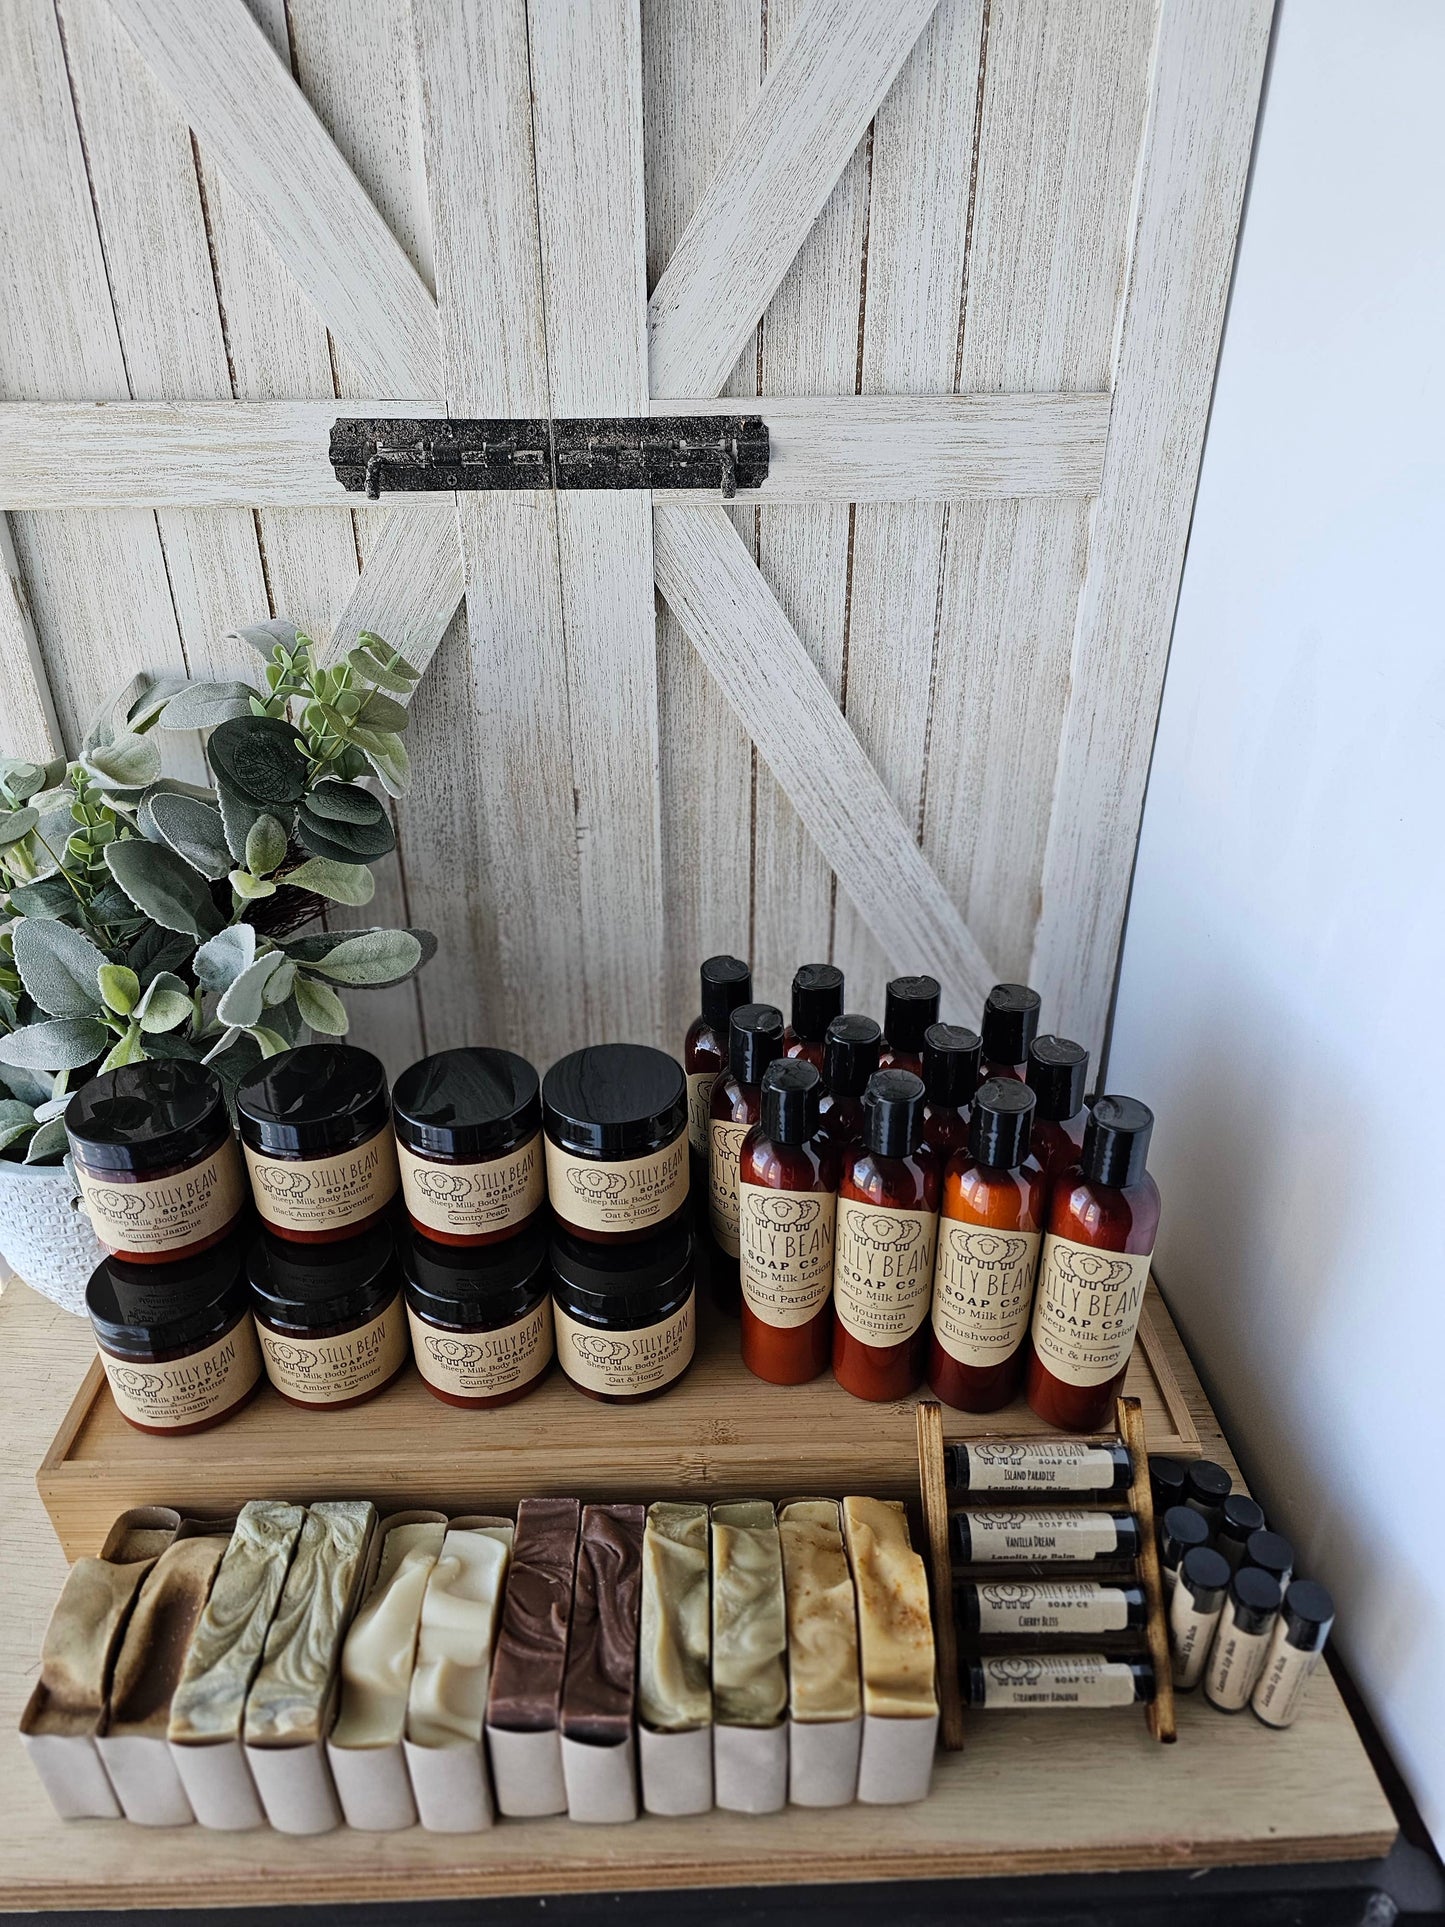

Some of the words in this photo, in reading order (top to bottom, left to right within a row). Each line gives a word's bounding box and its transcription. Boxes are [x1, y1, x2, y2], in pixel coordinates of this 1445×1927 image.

[312, 1168, 346, 1188] SILLY
[350, 1146, 379, 1178] BEAN
[474, 1171, 505, 1192] SILLY
[510, 1150, 534, 1181] BEAN
[629, 1166, 658, 1188] SILLY
[662, 1144, 683, 1176] BEAN
[146, 1187, 182, 1209] SILLY
[187, 1165, 217, 1198] BEAN
[271, 1194, 293, 1204] Sheep
[319, 1193, 340, 1204] Body
[344, 1182, 369, 1197] Butter
[327, 1182, 356, 1195] SOAP
[429, 1197, 453, 1208] Sheep
[479, 1197, 499, 1207] Body
[502, 1186, 525, 1200] Butter
[486, 1184, 513, 1198] SOAP
[582, 1196, 607, 1206] Sheep
[632, 1193, 652, 1204] Body
[655, 1181, 675, 1196] Butter
[640, 1180, 665, 1193] SOAP
[106, 1217, 129, 1226] Sheep
[155, 1215, 178, 1225] Body
[182, 1201, 209, 1217] Butter
[163, 1200, 194, 1215] SOAP
[273, 1206, 293, 1217] Black
[297, 1210, 325, 1218] Amber
[339, 1194, 374, 1213] Lavender
[448, 1213, 483, 1221] Country
[486, 1207, 510, 1218] Peach
[634, 1204, 659, 1216] Honey
[119, 1231, 160, 1239] Mountain
[163, 1220, 201, 1236] Jasmine
[741, 1209, 776, 1256] SILLY
[786, 1216, 831, 1258] BEAN
[748, 1249, 789, 1270] SOAP
[838, 1224, 874, 1274] SILLY
[883, 1238, 931, 1277] BEAN
[772, 1273, 797, 1282] Milk
[802, 1261, 831, 1280] Lotion
[844, 1265, 885, 1289] SOAP
[938, 1243, 978, 1293] SILLY
[988, 1256, 1035, 1295] BEAN
[747, 1280, 775, 1302] Island
[781, 1286, 826, 1303] Paradise
[866, 1291, 892, 1302] Milk
[898, 1284, 927, 1301] Lotion
[945, 1285, 990, 1308] SOAP
[1041, 1259, 1080, 1312] SILLY
[1089, 1280, 1141, 1317] BEAN
[850, 1302, 906, 1321] Mountain
[970, 1310, 997, 1320] Milk
[1001, 1301, 1030, 1319] Lotion
[1047, 1301, 1091, 1328] SOAP
[853, 1315, 903, 1329] Jasmine
[945, 1321, 1010, 1341] Blushwood
[1071, 1329, 1098, 1340] Milk
[1103, 1324, 1134, 1340] Lotion
[319, 1345, 353, 1364] SILLY
[357, 1322, 385, 1354] BEAN
[485, 1336, 516, 1358] SILLY
[520, 1312, 544, 1345] BEAN
[632, 1336, 662, 1356] SILLY
[666, 1311, 688, 1343] BEAN
[441, 1363, 464, 1374] Sheep
[489, 1361, 510, 1372] Body
[513, 1347, 535, 1364] Butter
[497, 1348, 524, 1362] SOAP
[587, 1361, 611, 1371] Sheep
[635, 1360, 656, 1370] Body
[658, 1346, 680, 1362] Butter
[643, 1347, 670, 1360] SOAP
[1045, 1338, 1063, 1355] Oat
[1068, 1351, 1078, 1360] &
[1084, 1351, 1121, 1363] Honey
[164, 1367, 199, 1388] SILLY
[204, 1341, 235, 1375] BEAN
[279, 1366, 300, 1378] Sheep
[325, 1368, 347, 1378] Body
[350, 1357, 376, 1372] Butter
[333, 1357, 362, 1370] SOAP
[180, 1377, 211, 1392] SOAP
[281, 1377, 300, 1388] Black
[303, 1382, 331, 1391] Amber
[344, 1367, 381, 1386] Lavender
[460, 1376, 495, 1385] Country
[497, 1369, 520, 1382] Peach
[637, 1369, 663, 1381] Honey
[125, 1392, 147, 1403] Sheep
[172, 1392, 196, 1402] Body
[199, 1377, 227, 1393] Butter
[137, 1407, 178, 1415] Mountain
[181, 1395, 220, 1412] Jasmine
